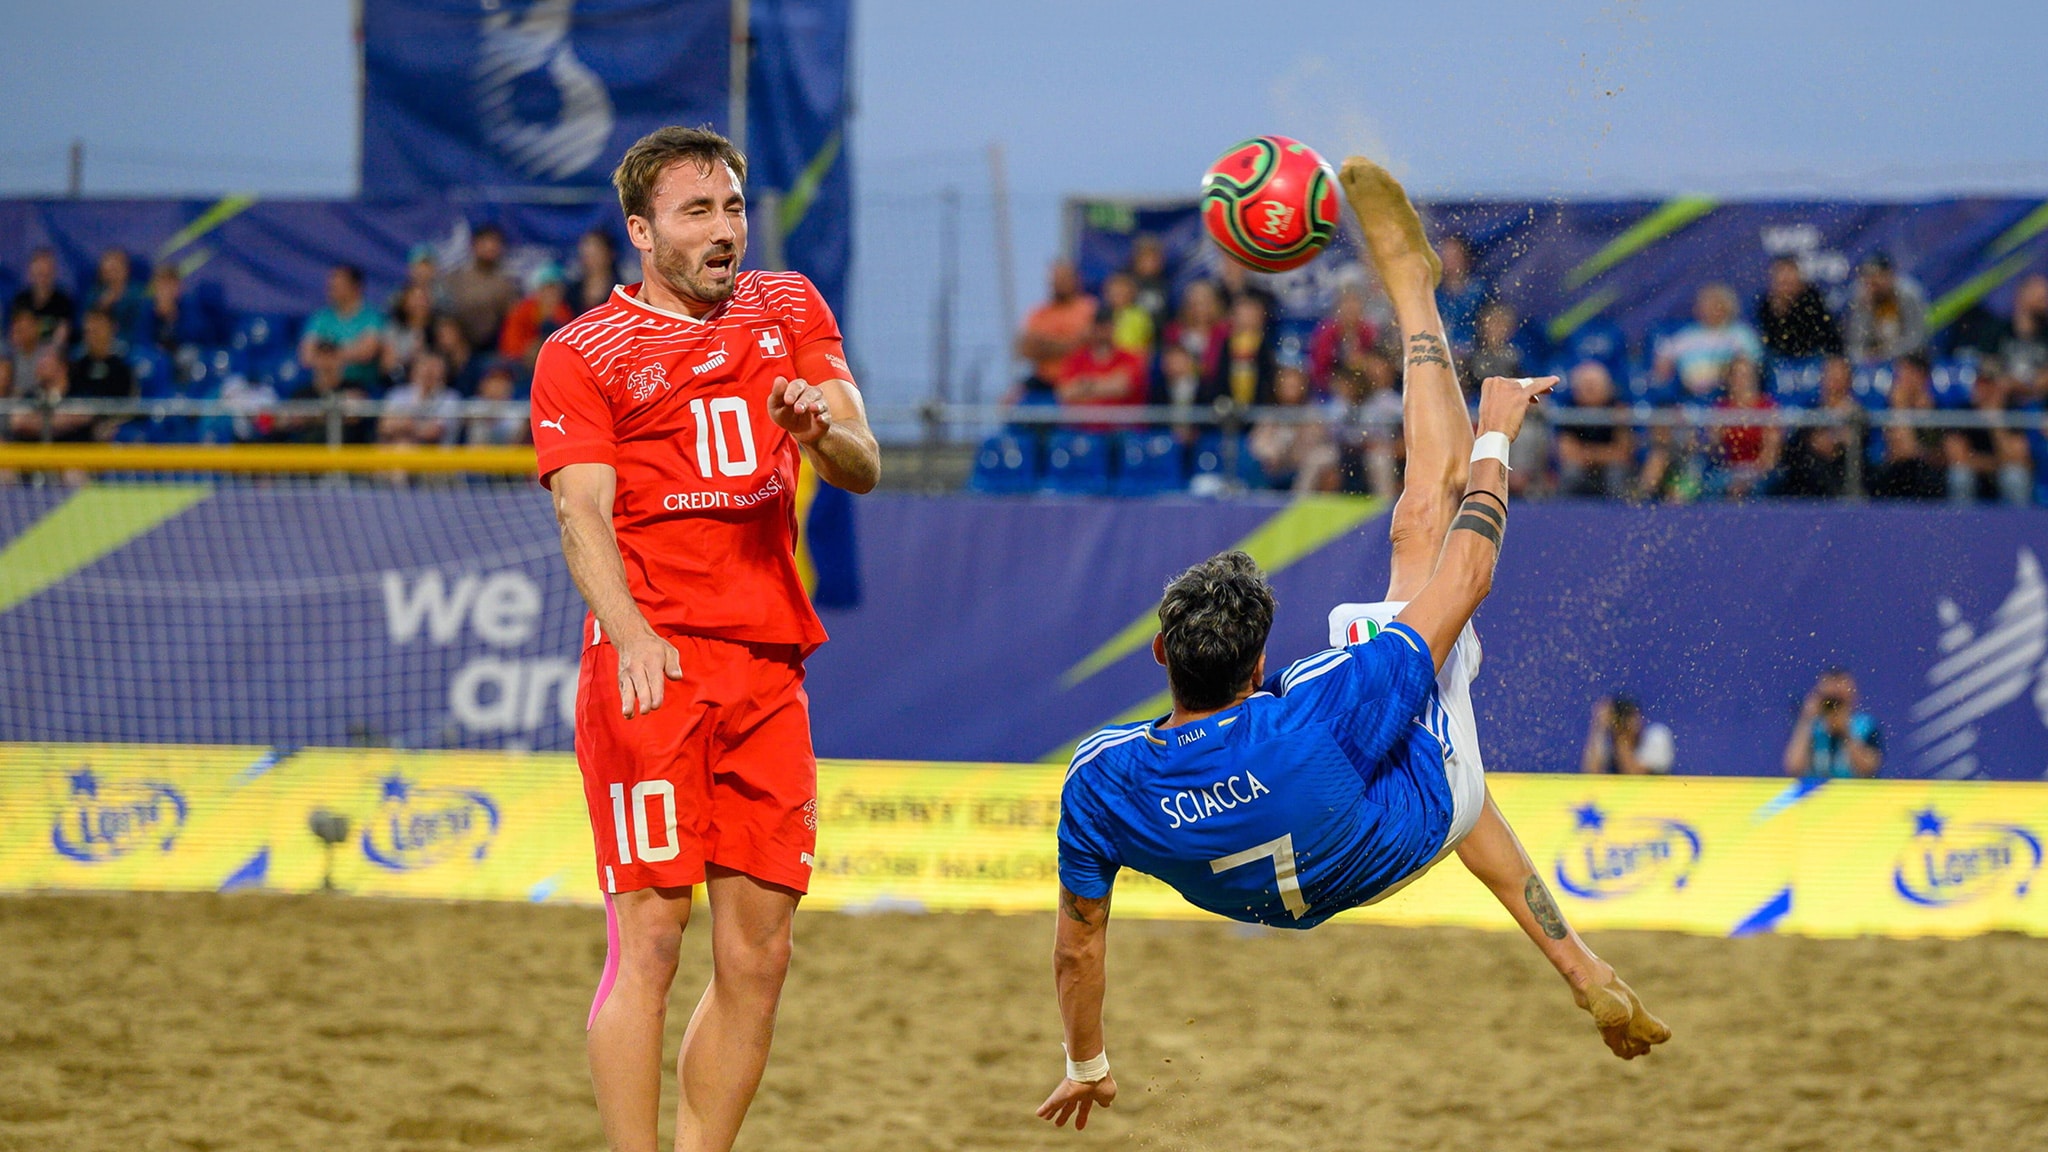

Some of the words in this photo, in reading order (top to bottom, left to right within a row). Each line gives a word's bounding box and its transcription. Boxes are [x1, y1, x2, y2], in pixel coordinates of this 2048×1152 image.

[691, 354, 726, 376] PUMA
[690, 396, 758, 478] 10
[663, 490, 730, 511] CREDIT
[382, 568, 542, 646] we
[1177, 728, 1207, 747] ITALIA
[609, 779, 681, 865] 10
[1160, 769, 1271, 829] SCIACCA
[1209, 832, 1312, 920] 7
